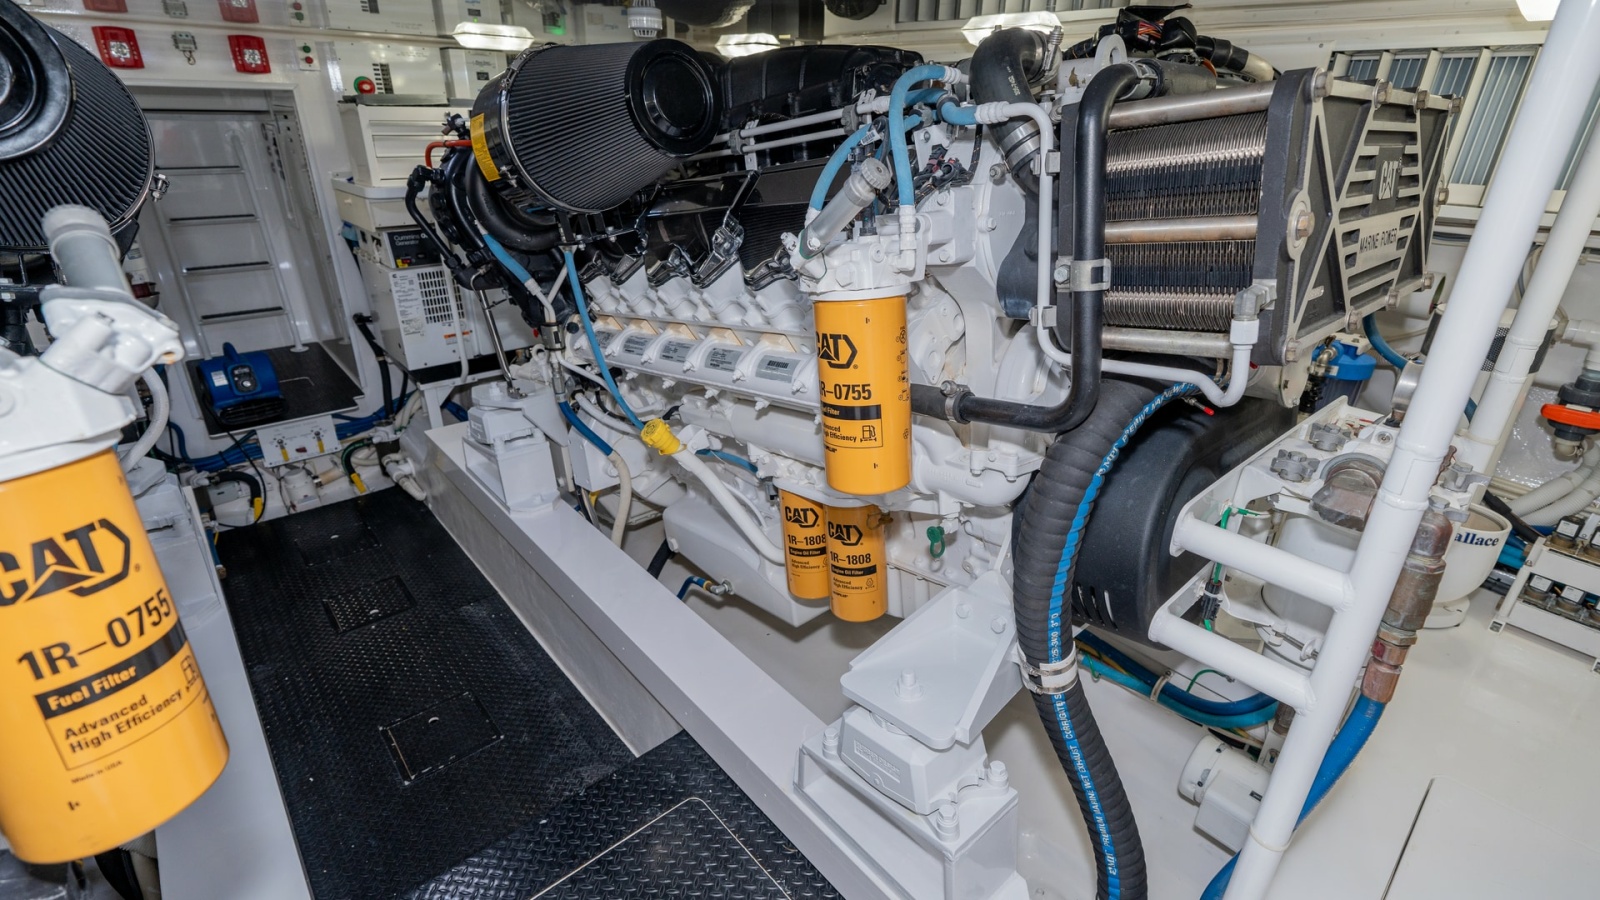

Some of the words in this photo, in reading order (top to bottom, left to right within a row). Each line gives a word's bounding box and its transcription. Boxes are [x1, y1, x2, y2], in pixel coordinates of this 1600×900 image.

[1379, 161, 1399, 200] CAT
[1360, 232, 1380, 254] MARINE
[1381, 228, 1398, 247] POWER
[820, 381, 872, 400] R-0755
[830, 431, 857, 442] Efficiency
[785, 506, 813, 526] CAT
[828, 521, 857, 543] CAT
[1454, 532, 1499, 546] allace
[0, 518, 110, 607] CAT
[47, 685, 91, 712] Fuel
[91, 666, 137, 694] Filter
[65, 694, 148, 740] Advanced
[69, 731, 112, 753] High
[116, 688, 182, 734] Efficiency
[1069, 745, 1088, 772] EXHAUST
[1081, 774, 1092, 789] WET
[1089, 790, 1102, 814] MARINE
[1096, 816, 1110, 847] PREMIUM
